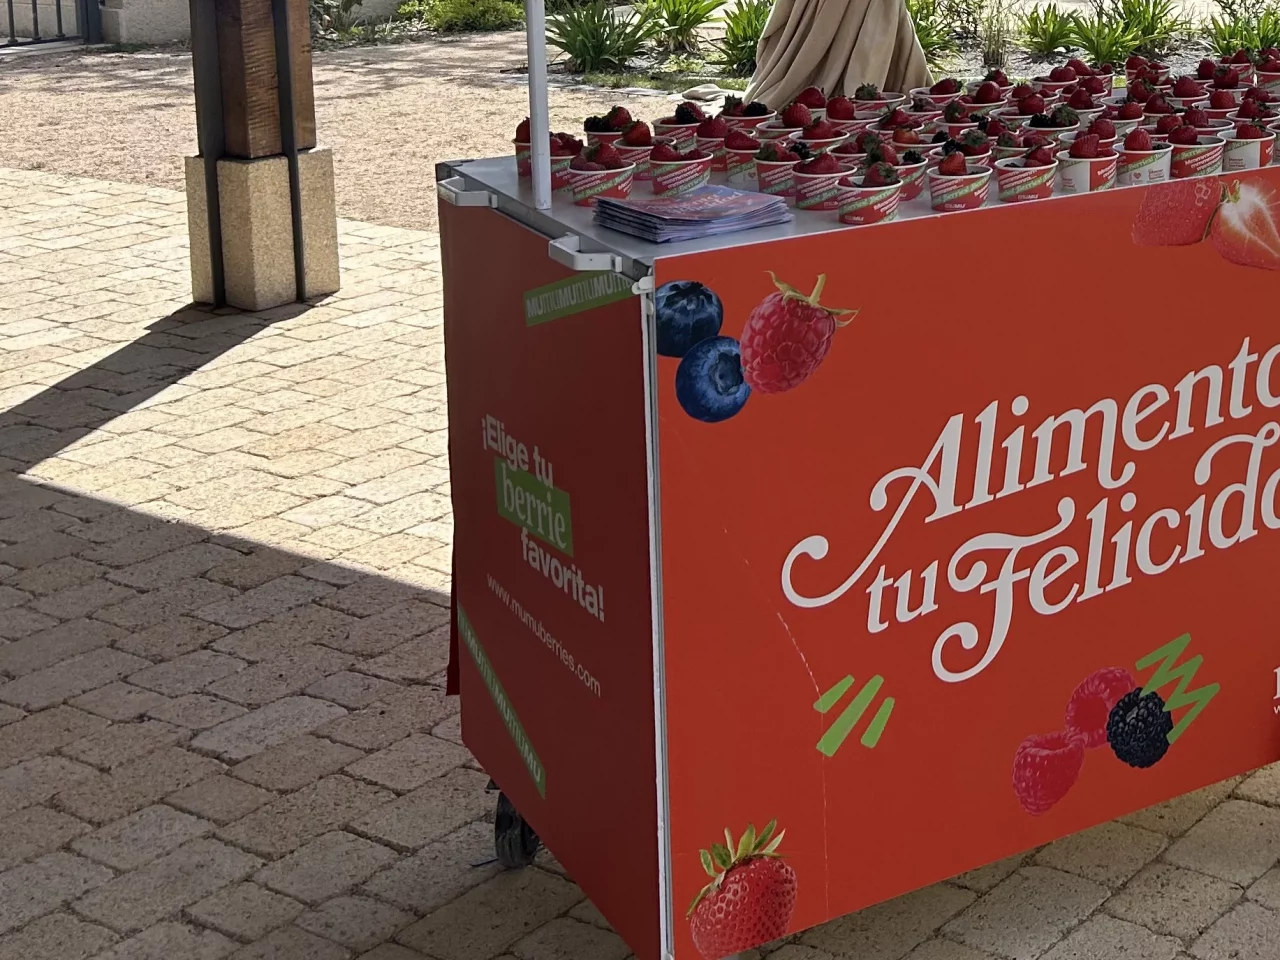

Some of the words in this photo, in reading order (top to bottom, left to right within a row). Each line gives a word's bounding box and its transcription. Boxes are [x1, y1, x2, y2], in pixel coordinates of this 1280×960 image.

[481, 413, 529, 472] ¡Elige
[533, 445, 554, 489] tu
[500, 462, 567, 550] berrie
[520, 526, 605, 624] favorita!
[866, 556, 940, 634] tu
[487, 572, 601, 699] www.mumuberries.com
